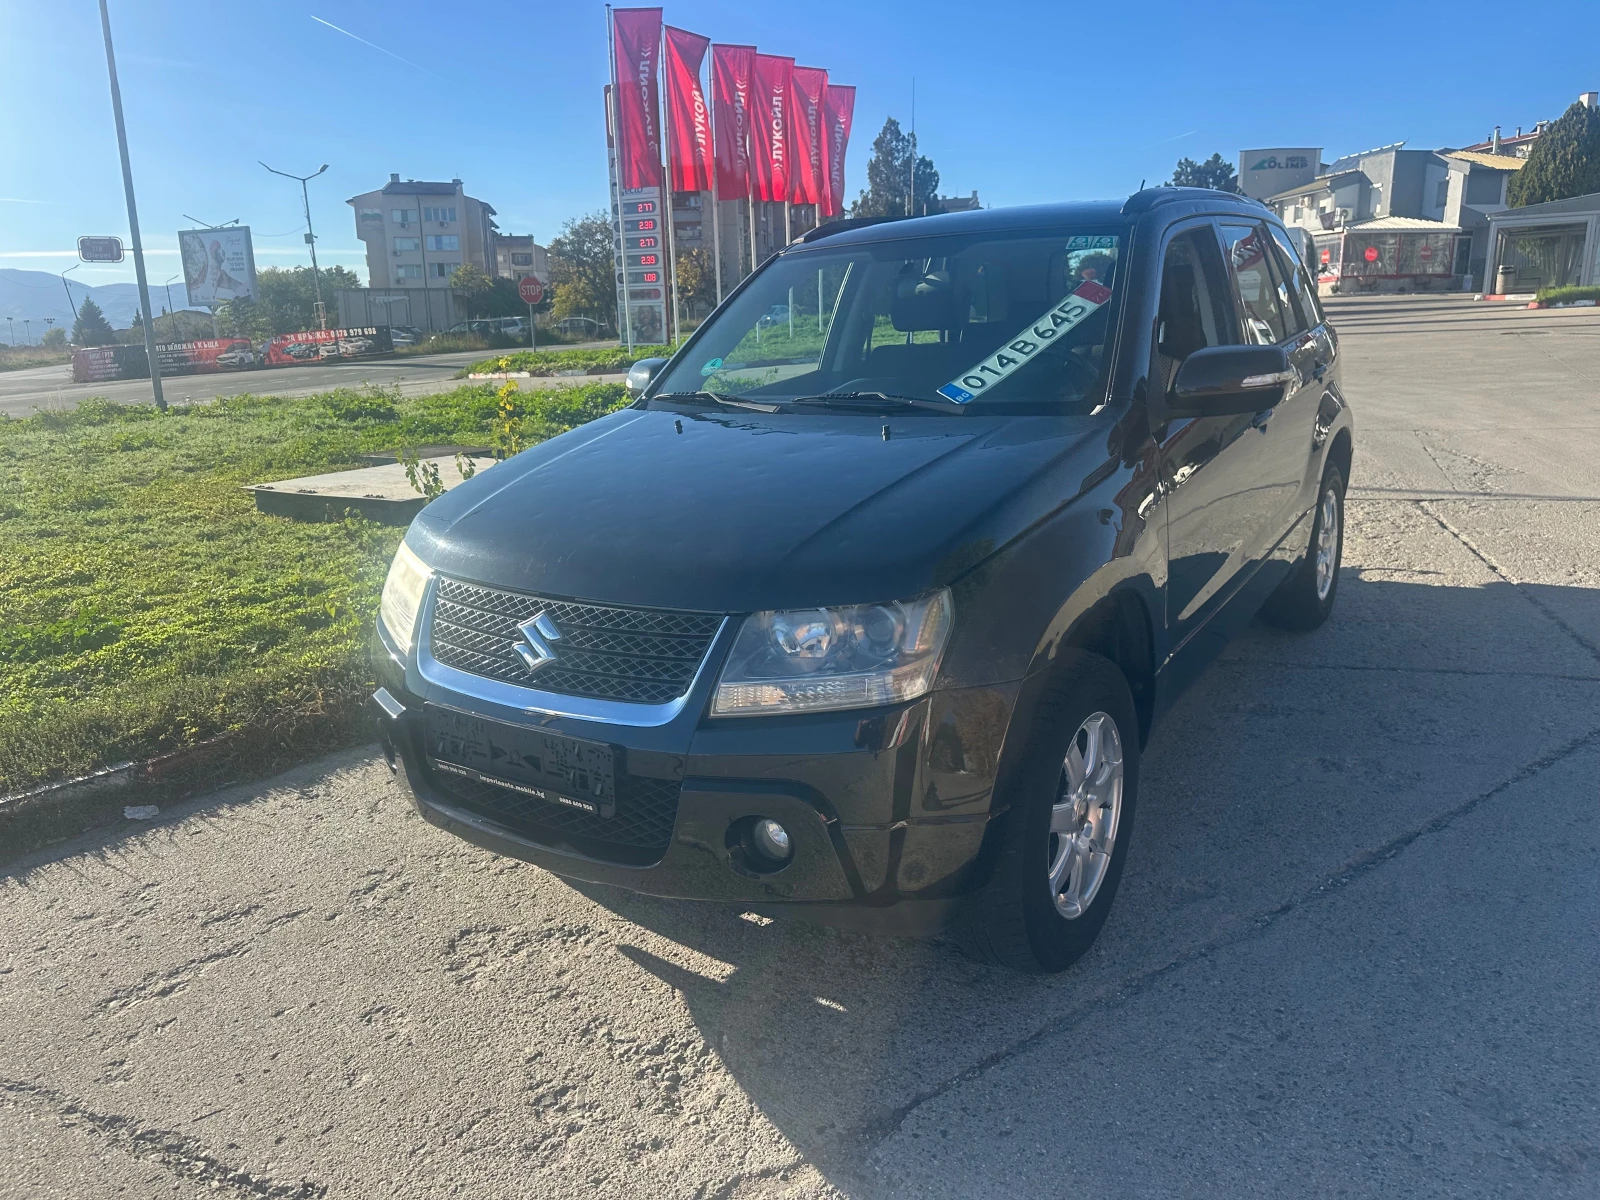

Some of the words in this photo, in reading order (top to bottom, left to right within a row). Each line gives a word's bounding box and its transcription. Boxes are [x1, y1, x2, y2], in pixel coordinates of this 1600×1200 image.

[692, 83, 706, 145] ЛУКОЙ
[771, 96, 783, 161] ЛУКОЙЛ
[1268, 160, 1308, 169] OLIMP
[521, 285, 541, 295] STOP
[349, 328, 362, 337] 979
[197, 340, 219, 349] КЪЩА
[955, 392, 970, 402] BG
